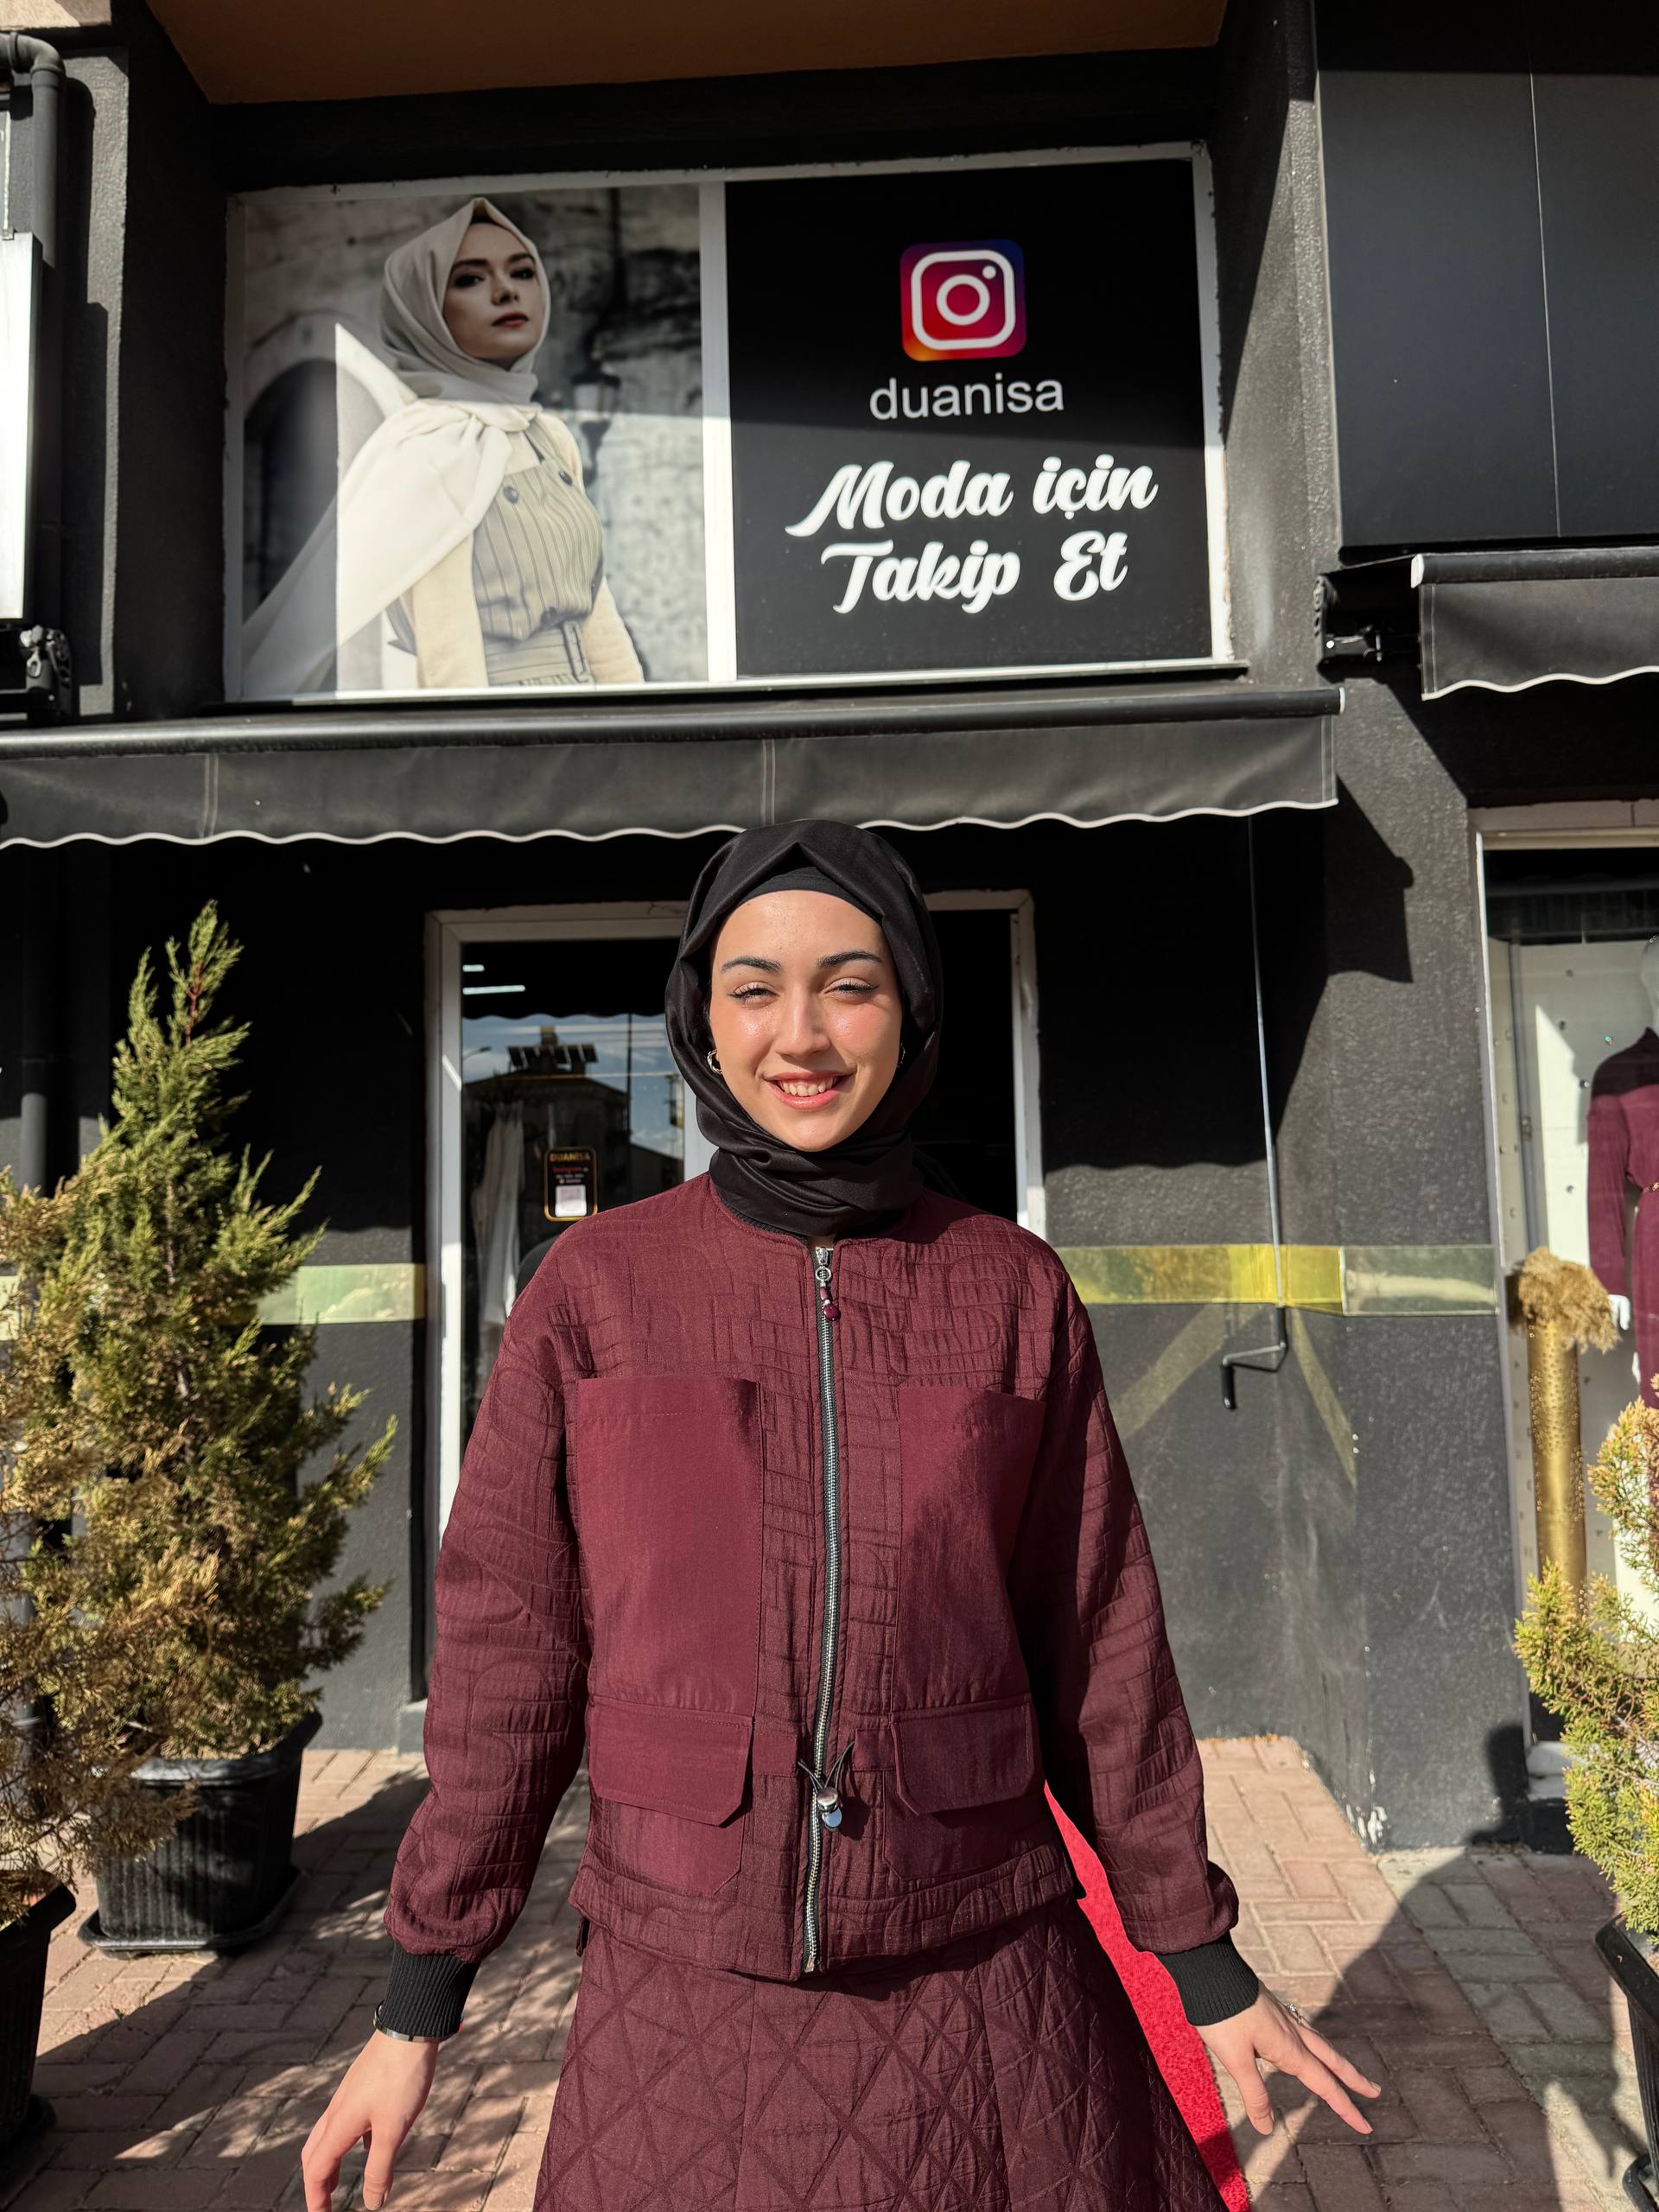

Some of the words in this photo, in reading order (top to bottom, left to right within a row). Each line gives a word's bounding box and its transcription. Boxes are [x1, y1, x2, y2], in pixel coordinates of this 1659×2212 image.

[869, 372, 1064, 420] duanisa
[785, 460, 1014, 537] Moda
[1033, 454, 1159, 520] için
[821, 539, 1020, 614] Takip
[1053, 530, 1128, 601] Et
